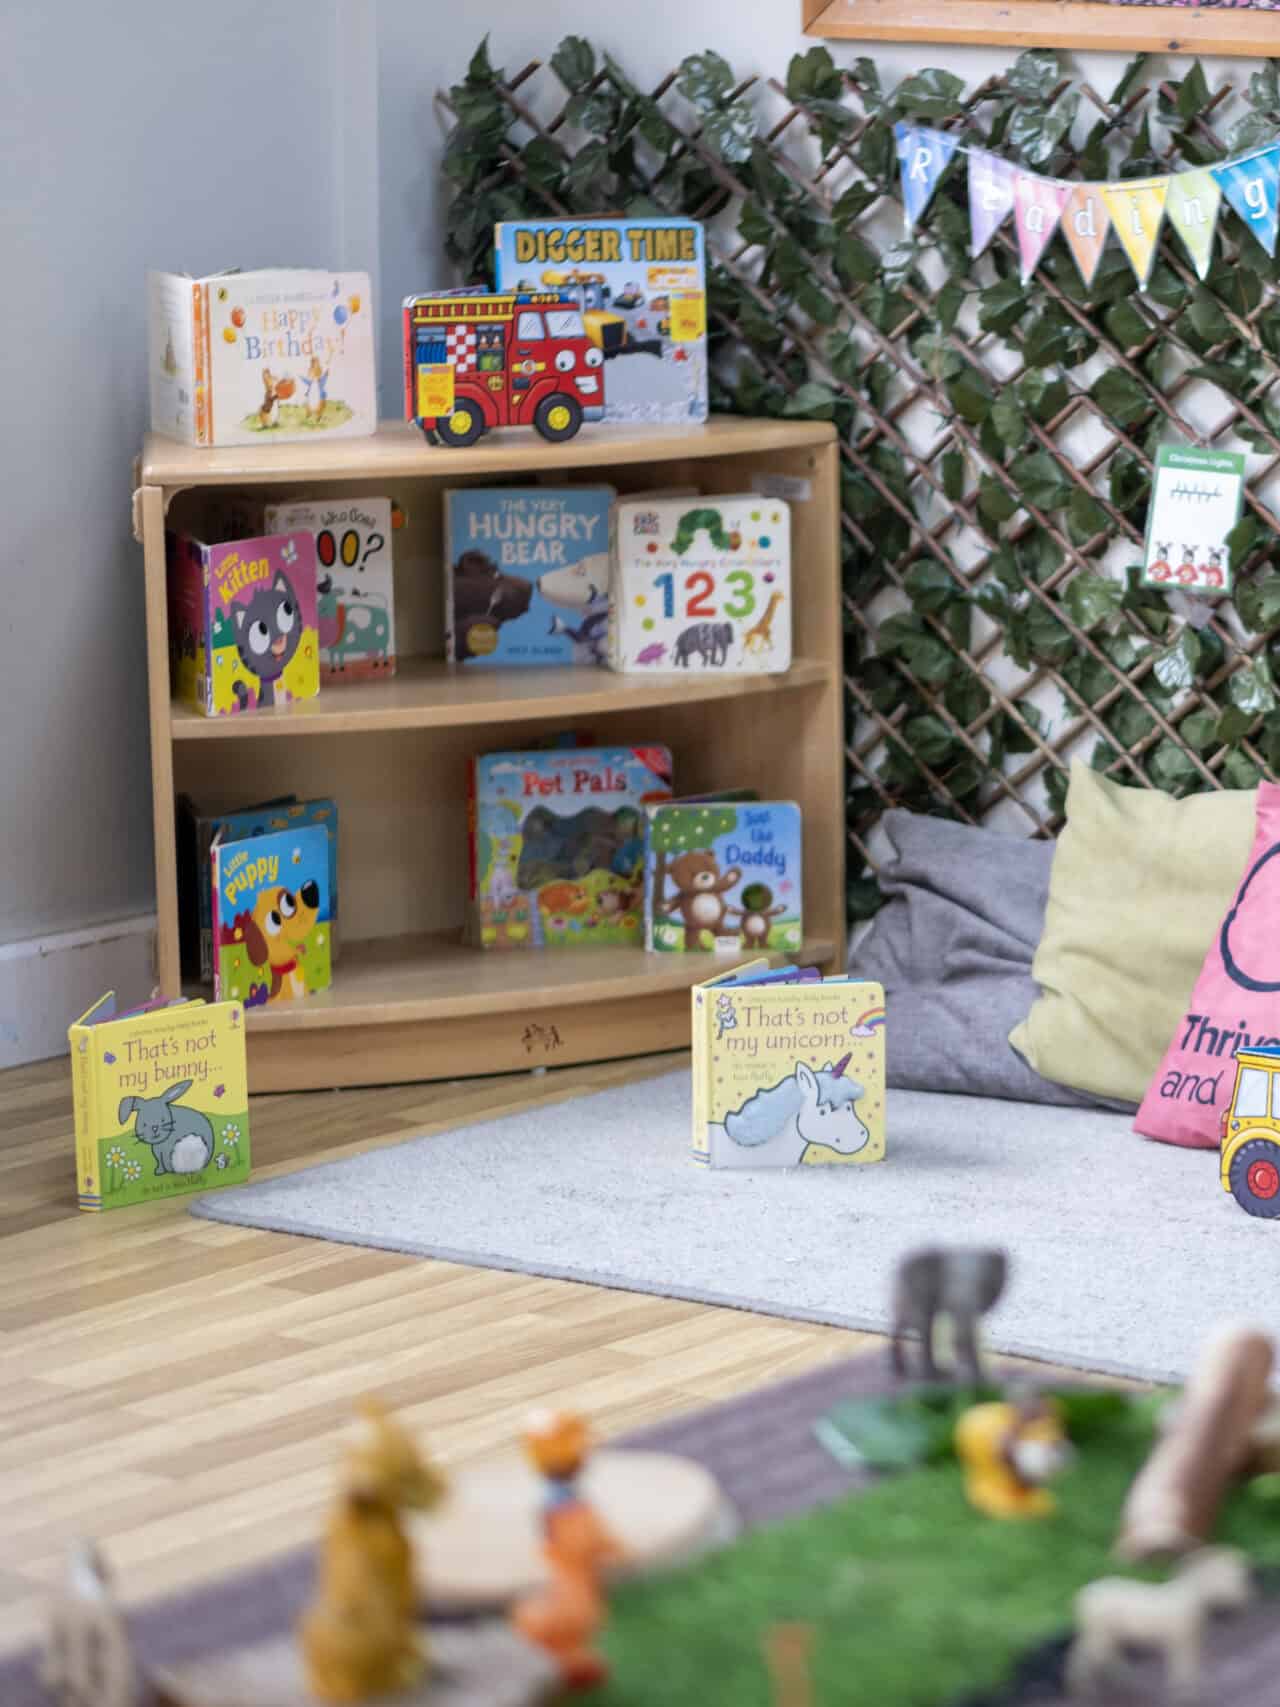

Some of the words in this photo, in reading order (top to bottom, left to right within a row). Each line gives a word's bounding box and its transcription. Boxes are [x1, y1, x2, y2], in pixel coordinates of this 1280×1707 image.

[515, 228, 620, 263] DIGGER
[627, 227, 697, 261] TIME
[500, 498, 526, 512] THE
[530, 498, 566, 512] VERY
[469, 511, 601, 541] HUNGRY
[502, 540, 567, 565] BEAR
[523, 770, 563, 796] Pet
[573, 767, 627, 793] Pals
[726, 844, 786, 875] Daddy
[742, 1005, 806, 1028] That's
[813, 1006, 848, 1025] not
[122, 1036, 178, 1064] That's
[185, 1028, 216, 1053] not
[726, 1037, 758, 1057] my
[119, 1072, 148, 1092] my
[1160, 1070, 1224, 1105] and
